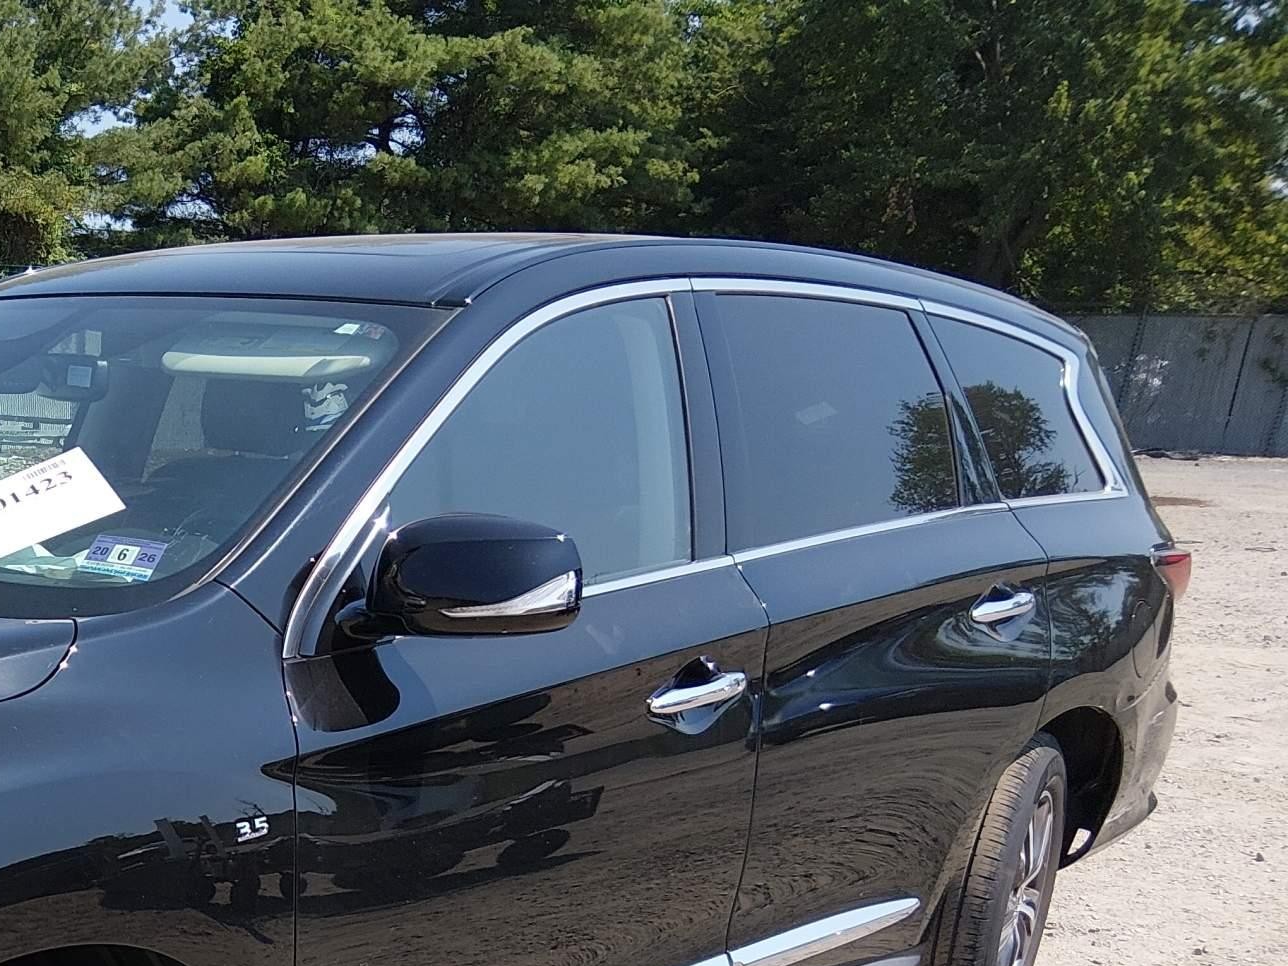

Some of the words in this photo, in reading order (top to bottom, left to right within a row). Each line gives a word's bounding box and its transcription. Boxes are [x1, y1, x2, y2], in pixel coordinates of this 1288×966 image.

[93, 545, 109, 556] 20
[117, 548, 129, 561] 6
[138, 552, 156, 563] 26
